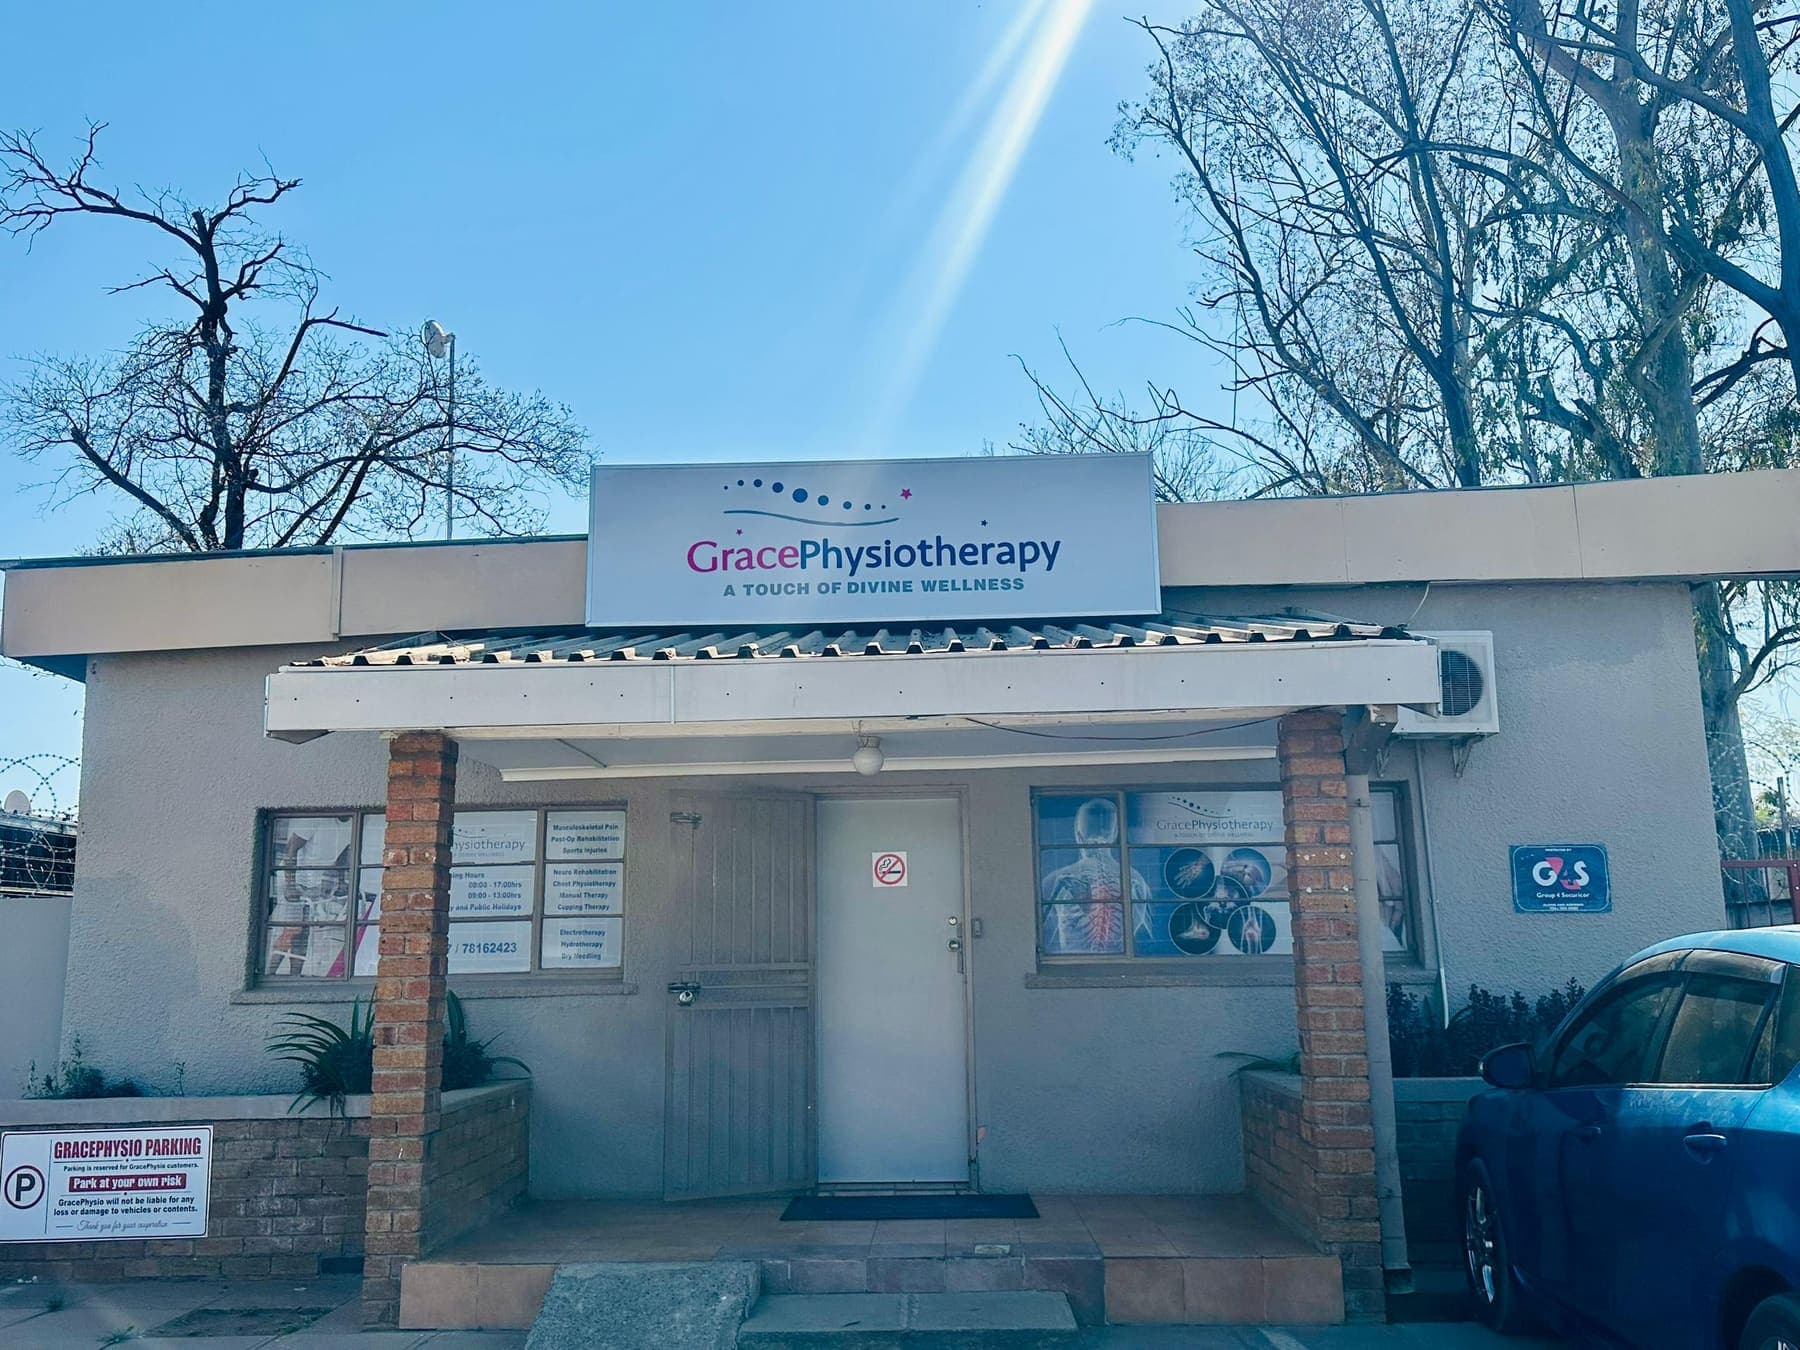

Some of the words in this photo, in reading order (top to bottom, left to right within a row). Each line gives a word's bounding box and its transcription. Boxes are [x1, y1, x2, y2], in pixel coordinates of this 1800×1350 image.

[687, 535, 1061, 577] GracePhysiotherapy
[723, 584, 736, 597] A
[743, 583, 810, 596] TOUCH
[817, 582, 842, 595] OF
[847, 580, 913, 594] DIVINE
[921, 578, 1025, 593] WELLNESS
[553, 823, 604, 831] Musculoskeletal
[605, 823, 619, 831] Pain
[1156, 819, 1273, 832] GracePhysiotherapy
[584, 846, 608, 854] Injuries
[574, 868, 617, 876] Rehabilitation
[573, 880, 616, 888] Physiotherapy
[584, 892, 608, 900] Therapy
[492, 903, 522, 912] Holidays
[558, 904, 582, 912] Cupping
[584, 903, 610, 912] Therapy
[560, 928, 606, 936] Electrotherapy
[462, 942, 517, 954] 78162423
[560, 941, 603, 949] Hydrotherapy
[54, 1139, 142, 1159] GRACEPHYSIO
[145, 1137, 201, 1156] PARKING
[167, 1162, 199, 1170] customers.
[74, 1177, 97, 1189] Park
[100, 1178, 109, 1188] at
[112, 1178, 134, 1190] your
[138, 1178, 159, 1187] own
[161, 1175, 182, 1186] risk
[16, 1174, 36, 1202] P
[58, 1198, 104, 1208] GracePhysio
[146, 1196, 166, 1204] liable
[168, 1196, 179, 1204] for
[180, 1196, 194, 1204] any
[54, 1208, 69, 1216] loss
[80, 1208, 110, 1216] damage
[120, 1206, 152, 1214] vehicles
[162, 1205, 198, 1213] contents.
